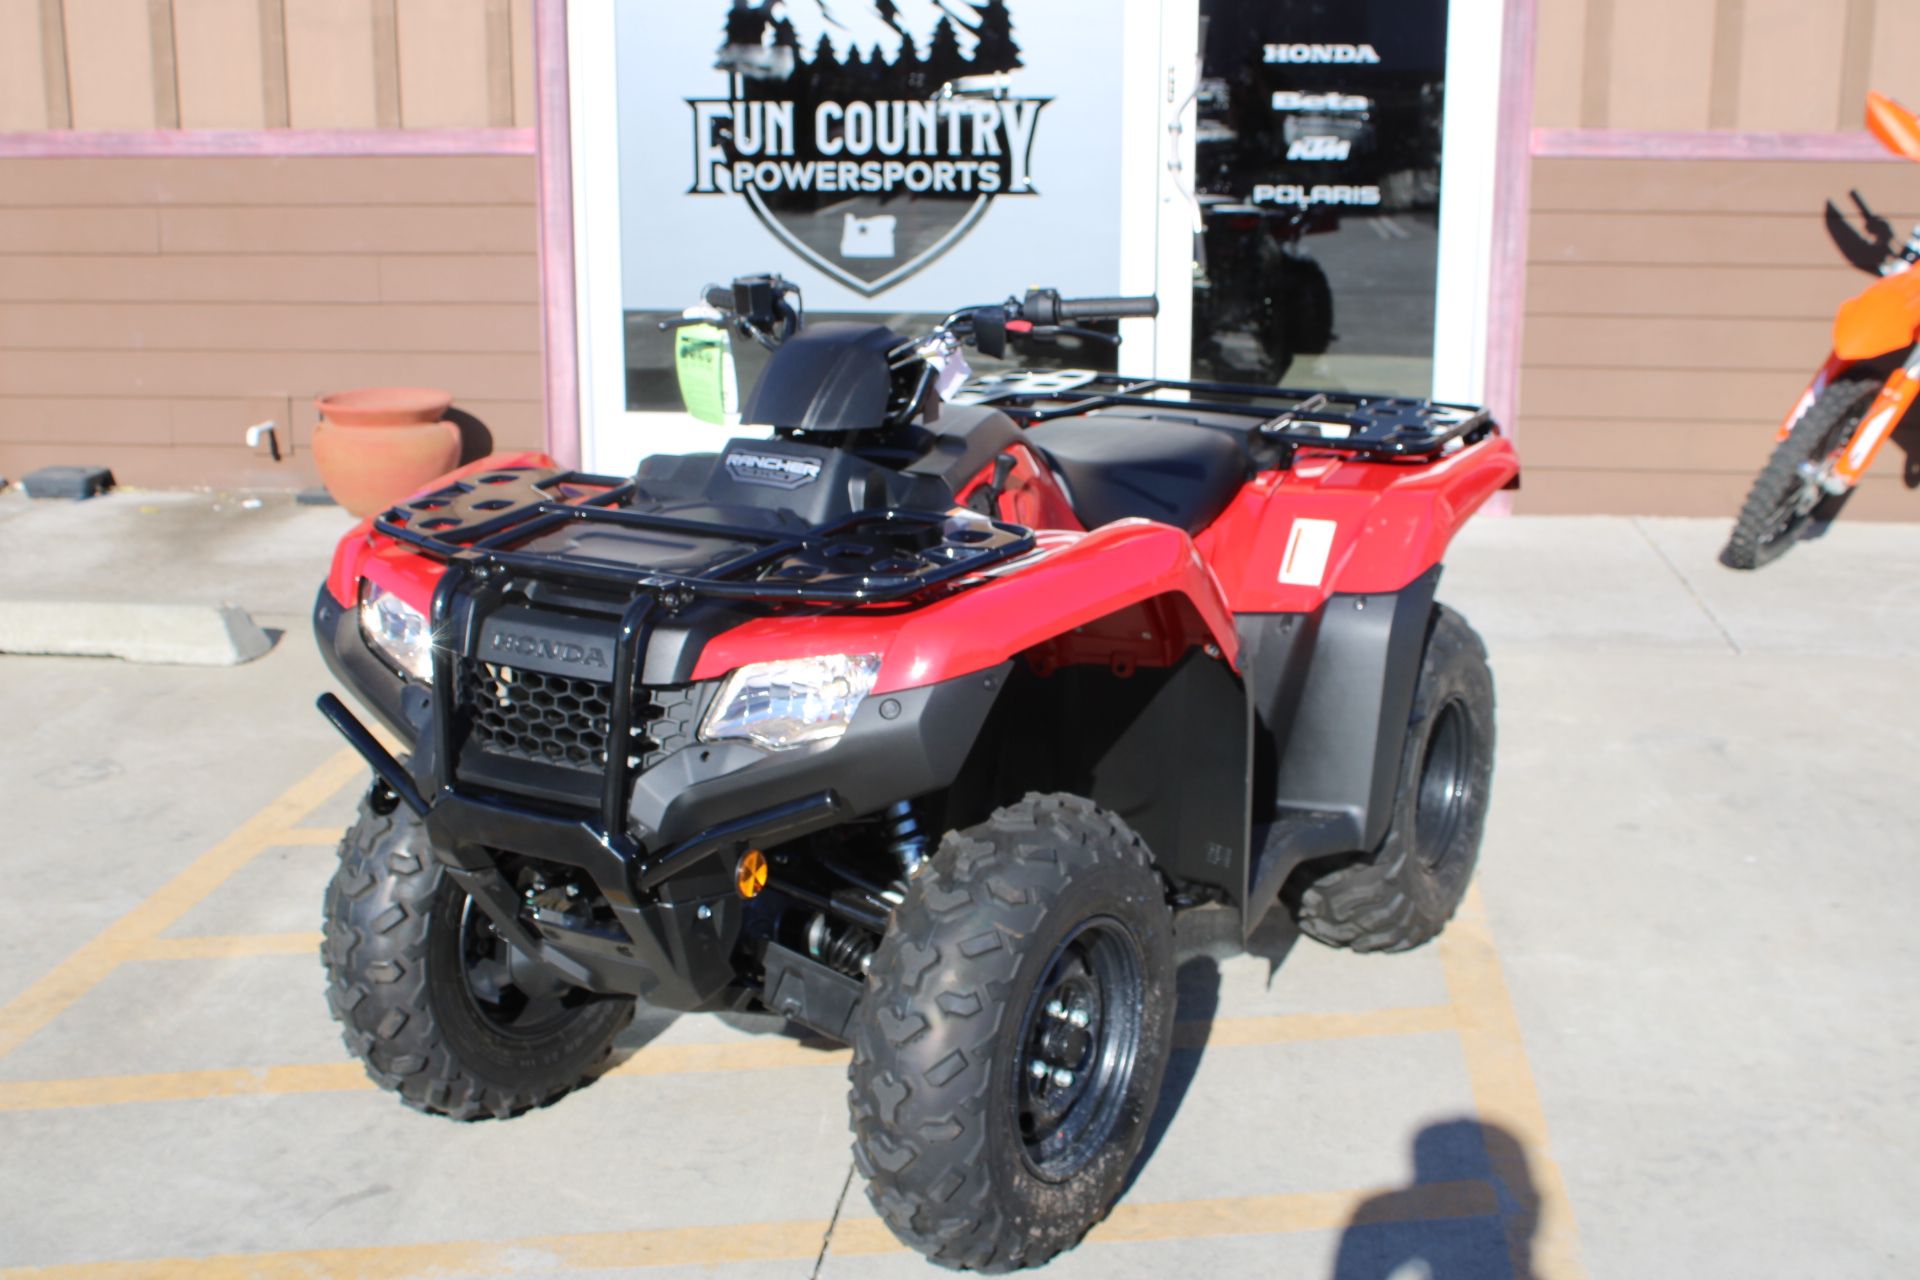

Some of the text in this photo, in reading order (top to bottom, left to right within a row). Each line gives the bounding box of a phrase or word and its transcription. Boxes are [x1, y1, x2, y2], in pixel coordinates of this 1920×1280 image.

[1263, 44, 1380, 63] HONDA
[686, 99, 1050, 195] FUN COUNTRY
[1286, 136, 1351, 160] KTM
[732, 160, 1001, 192] POWERSPORTS
[1253, 185, 1381, 205] POLARIS
[726, 453, 820, 477] RANCHER
[492, 632, 608, 668] HONDA
